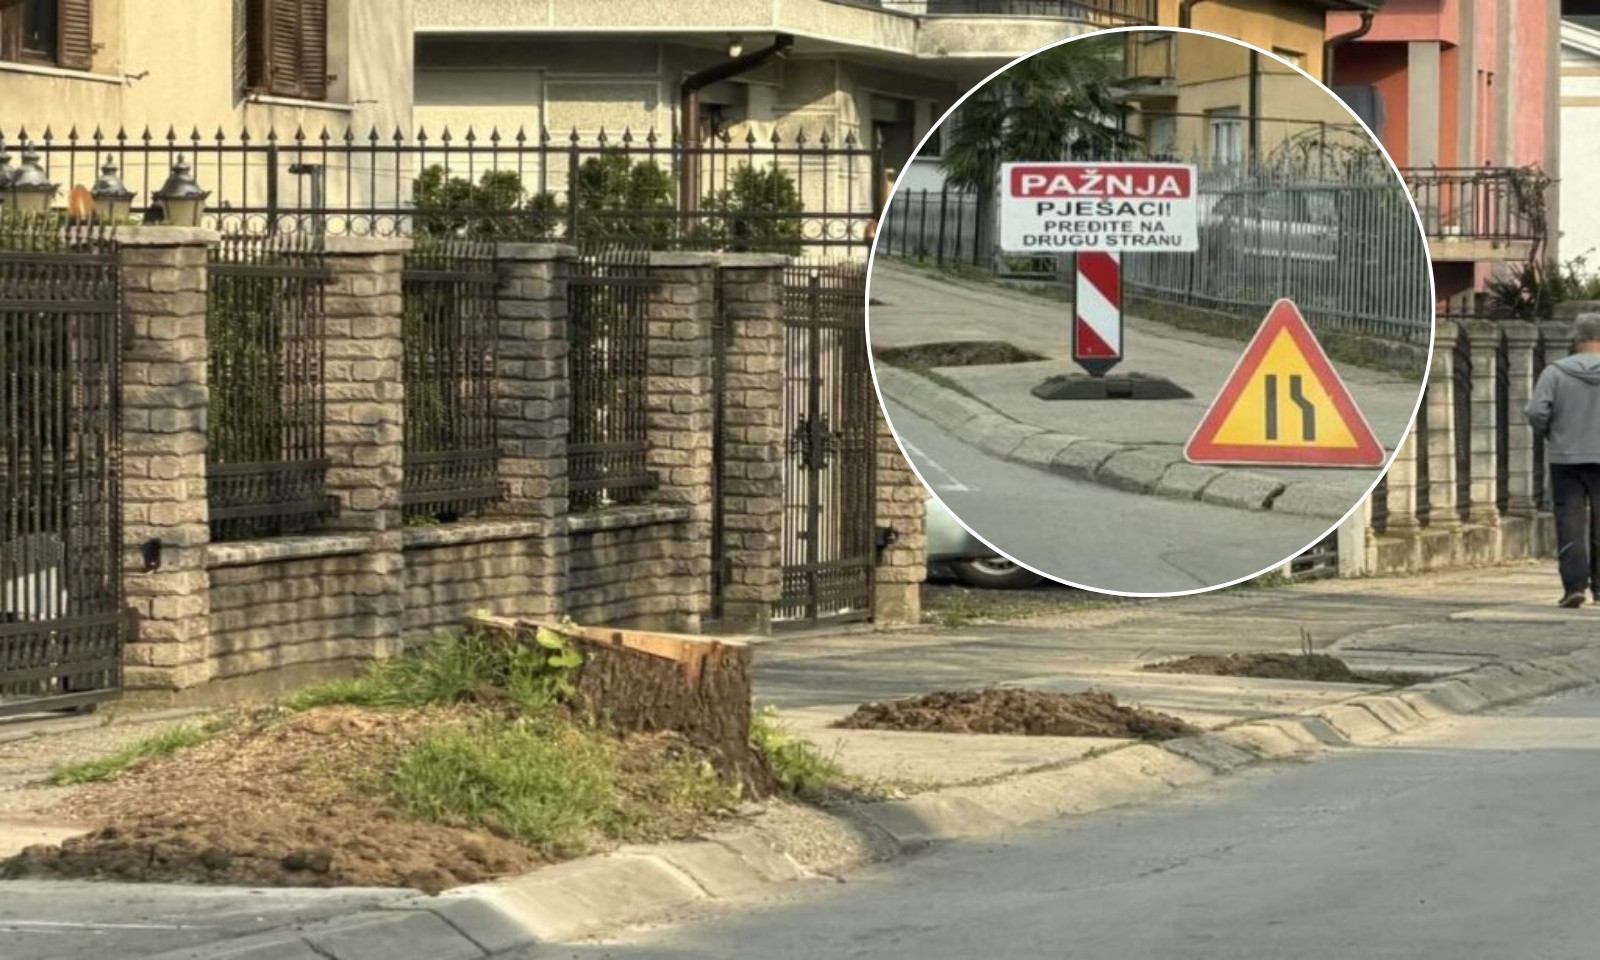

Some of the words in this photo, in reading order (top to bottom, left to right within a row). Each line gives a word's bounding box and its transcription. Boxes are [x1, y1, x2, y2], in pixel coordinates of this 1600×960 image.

[1021, 168, 1182, 195] PAŽNJA
[1036, 198, 1171, 216] PJEŠACI!
[1140, 220, 1165, 232] NA
[1023, 234, 1098, 246] DRUGU
[1106, 234, 1182, 246] STRANU
